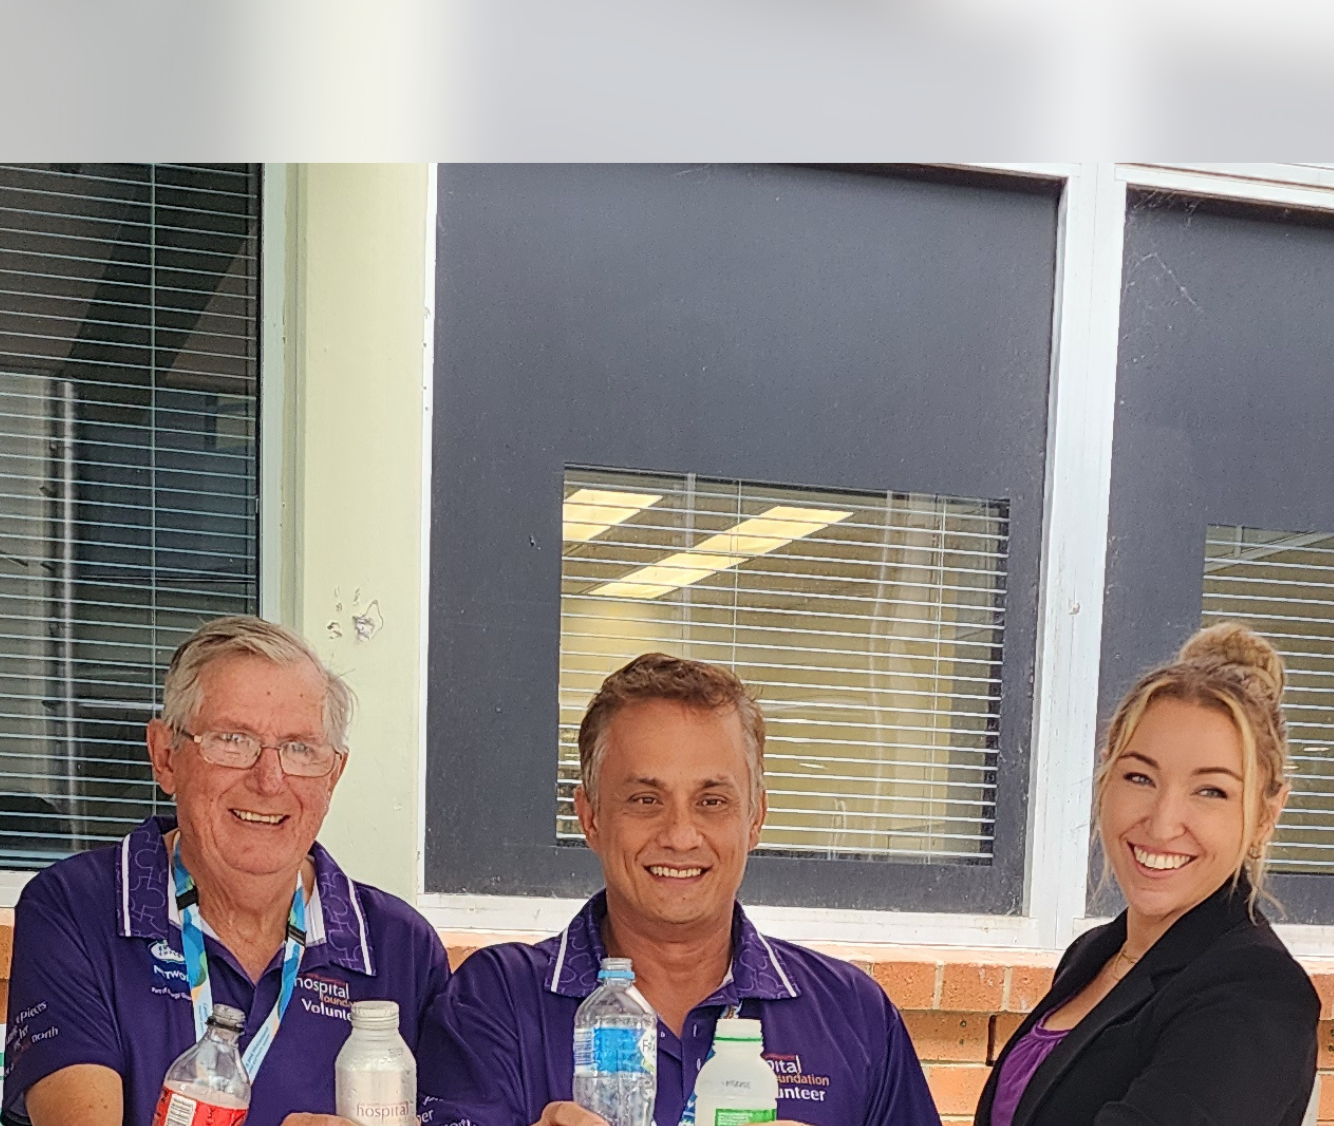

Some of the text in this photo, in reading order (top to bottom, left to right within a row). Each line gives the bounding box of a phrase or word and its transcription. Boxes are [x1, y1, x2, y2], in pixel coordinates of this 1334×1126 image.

[301, 998, 352, 1021] Volunte
[777, 1074, 829, 1086] undation
[778, 1087, 825, 1102] unteer
[357, 1101, 409, 1120] hospital
